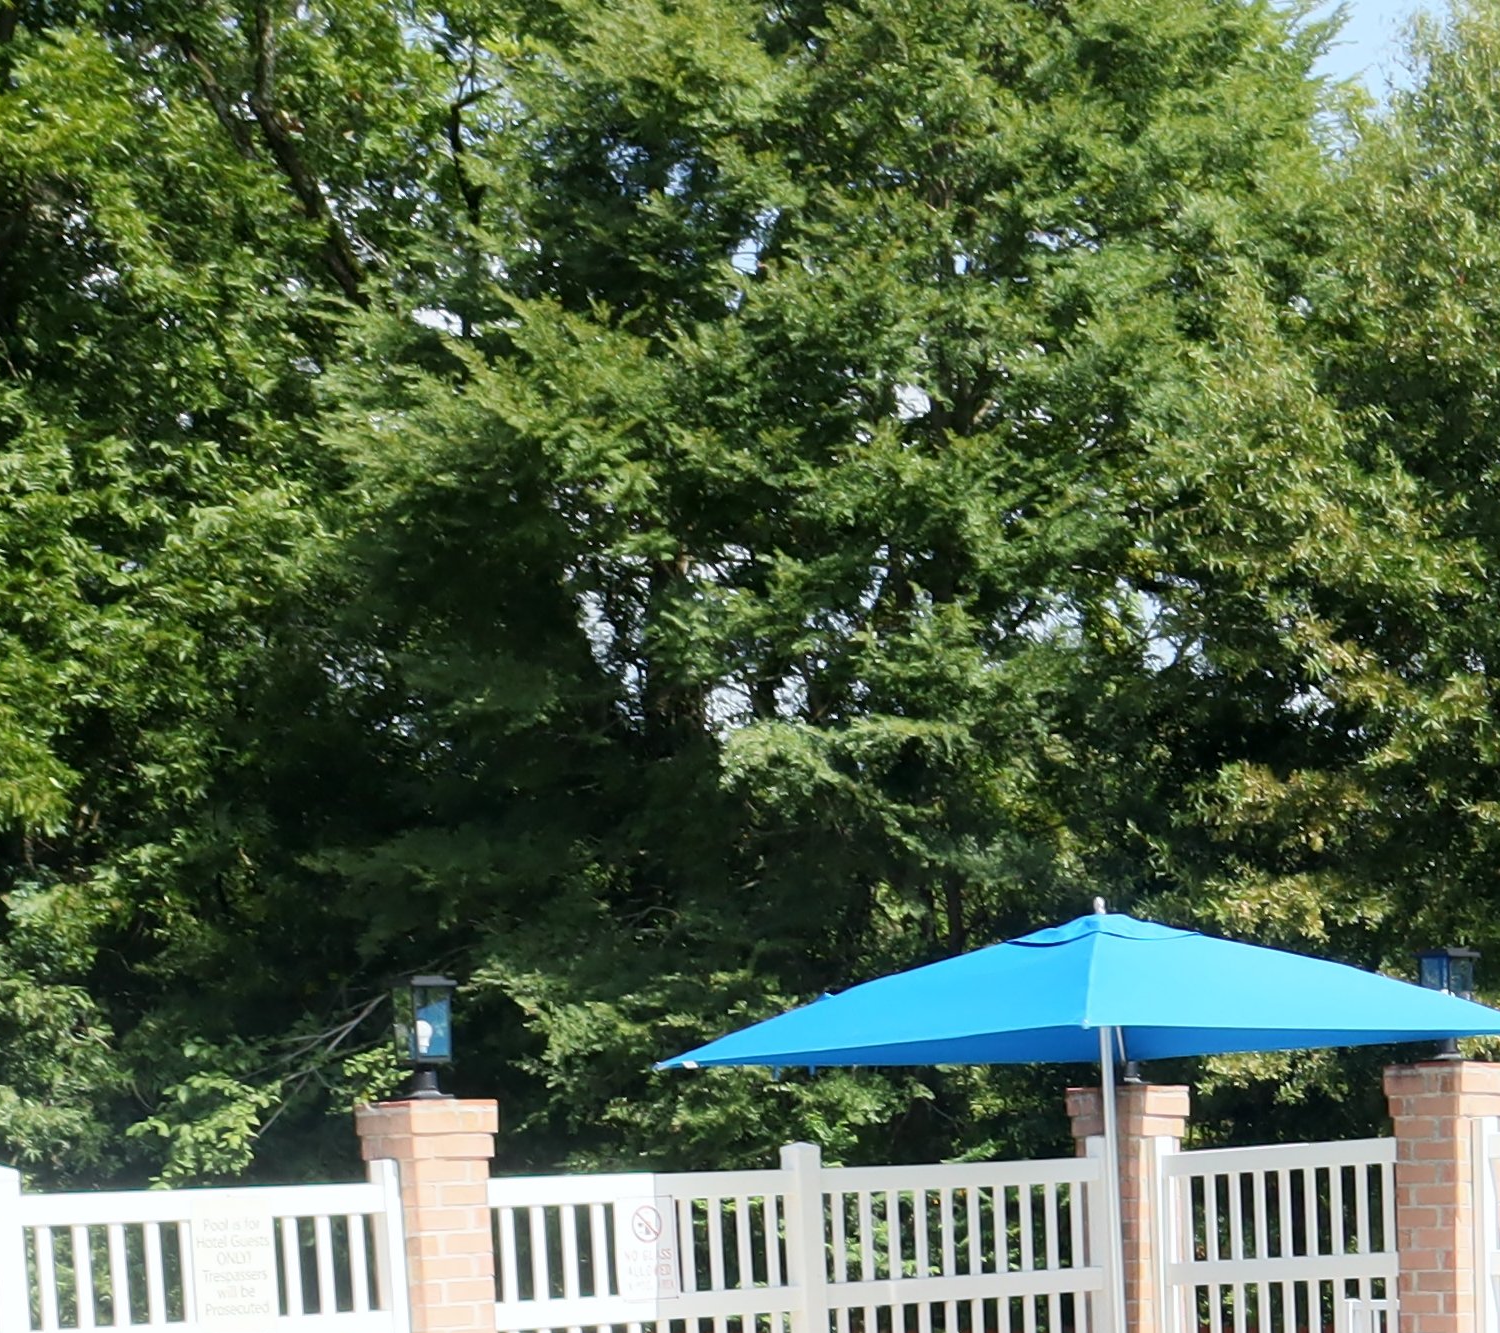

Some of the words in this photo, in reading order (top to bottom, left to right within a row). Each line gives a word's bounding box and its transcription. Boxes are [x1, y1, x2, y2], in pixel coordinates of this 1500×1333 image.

[203, 1218, 228, 1231] Pool
[244, 1217, 260, 1230] for
[196, 1235, 227, 1248] Hotel
[231, 1235, 270, 1247] Guests
[202, 1269, 268, 1283] Trespassers
[241, 1286, 256, 1297] be
[205, 1301, 270, 1316] Prosecuted
